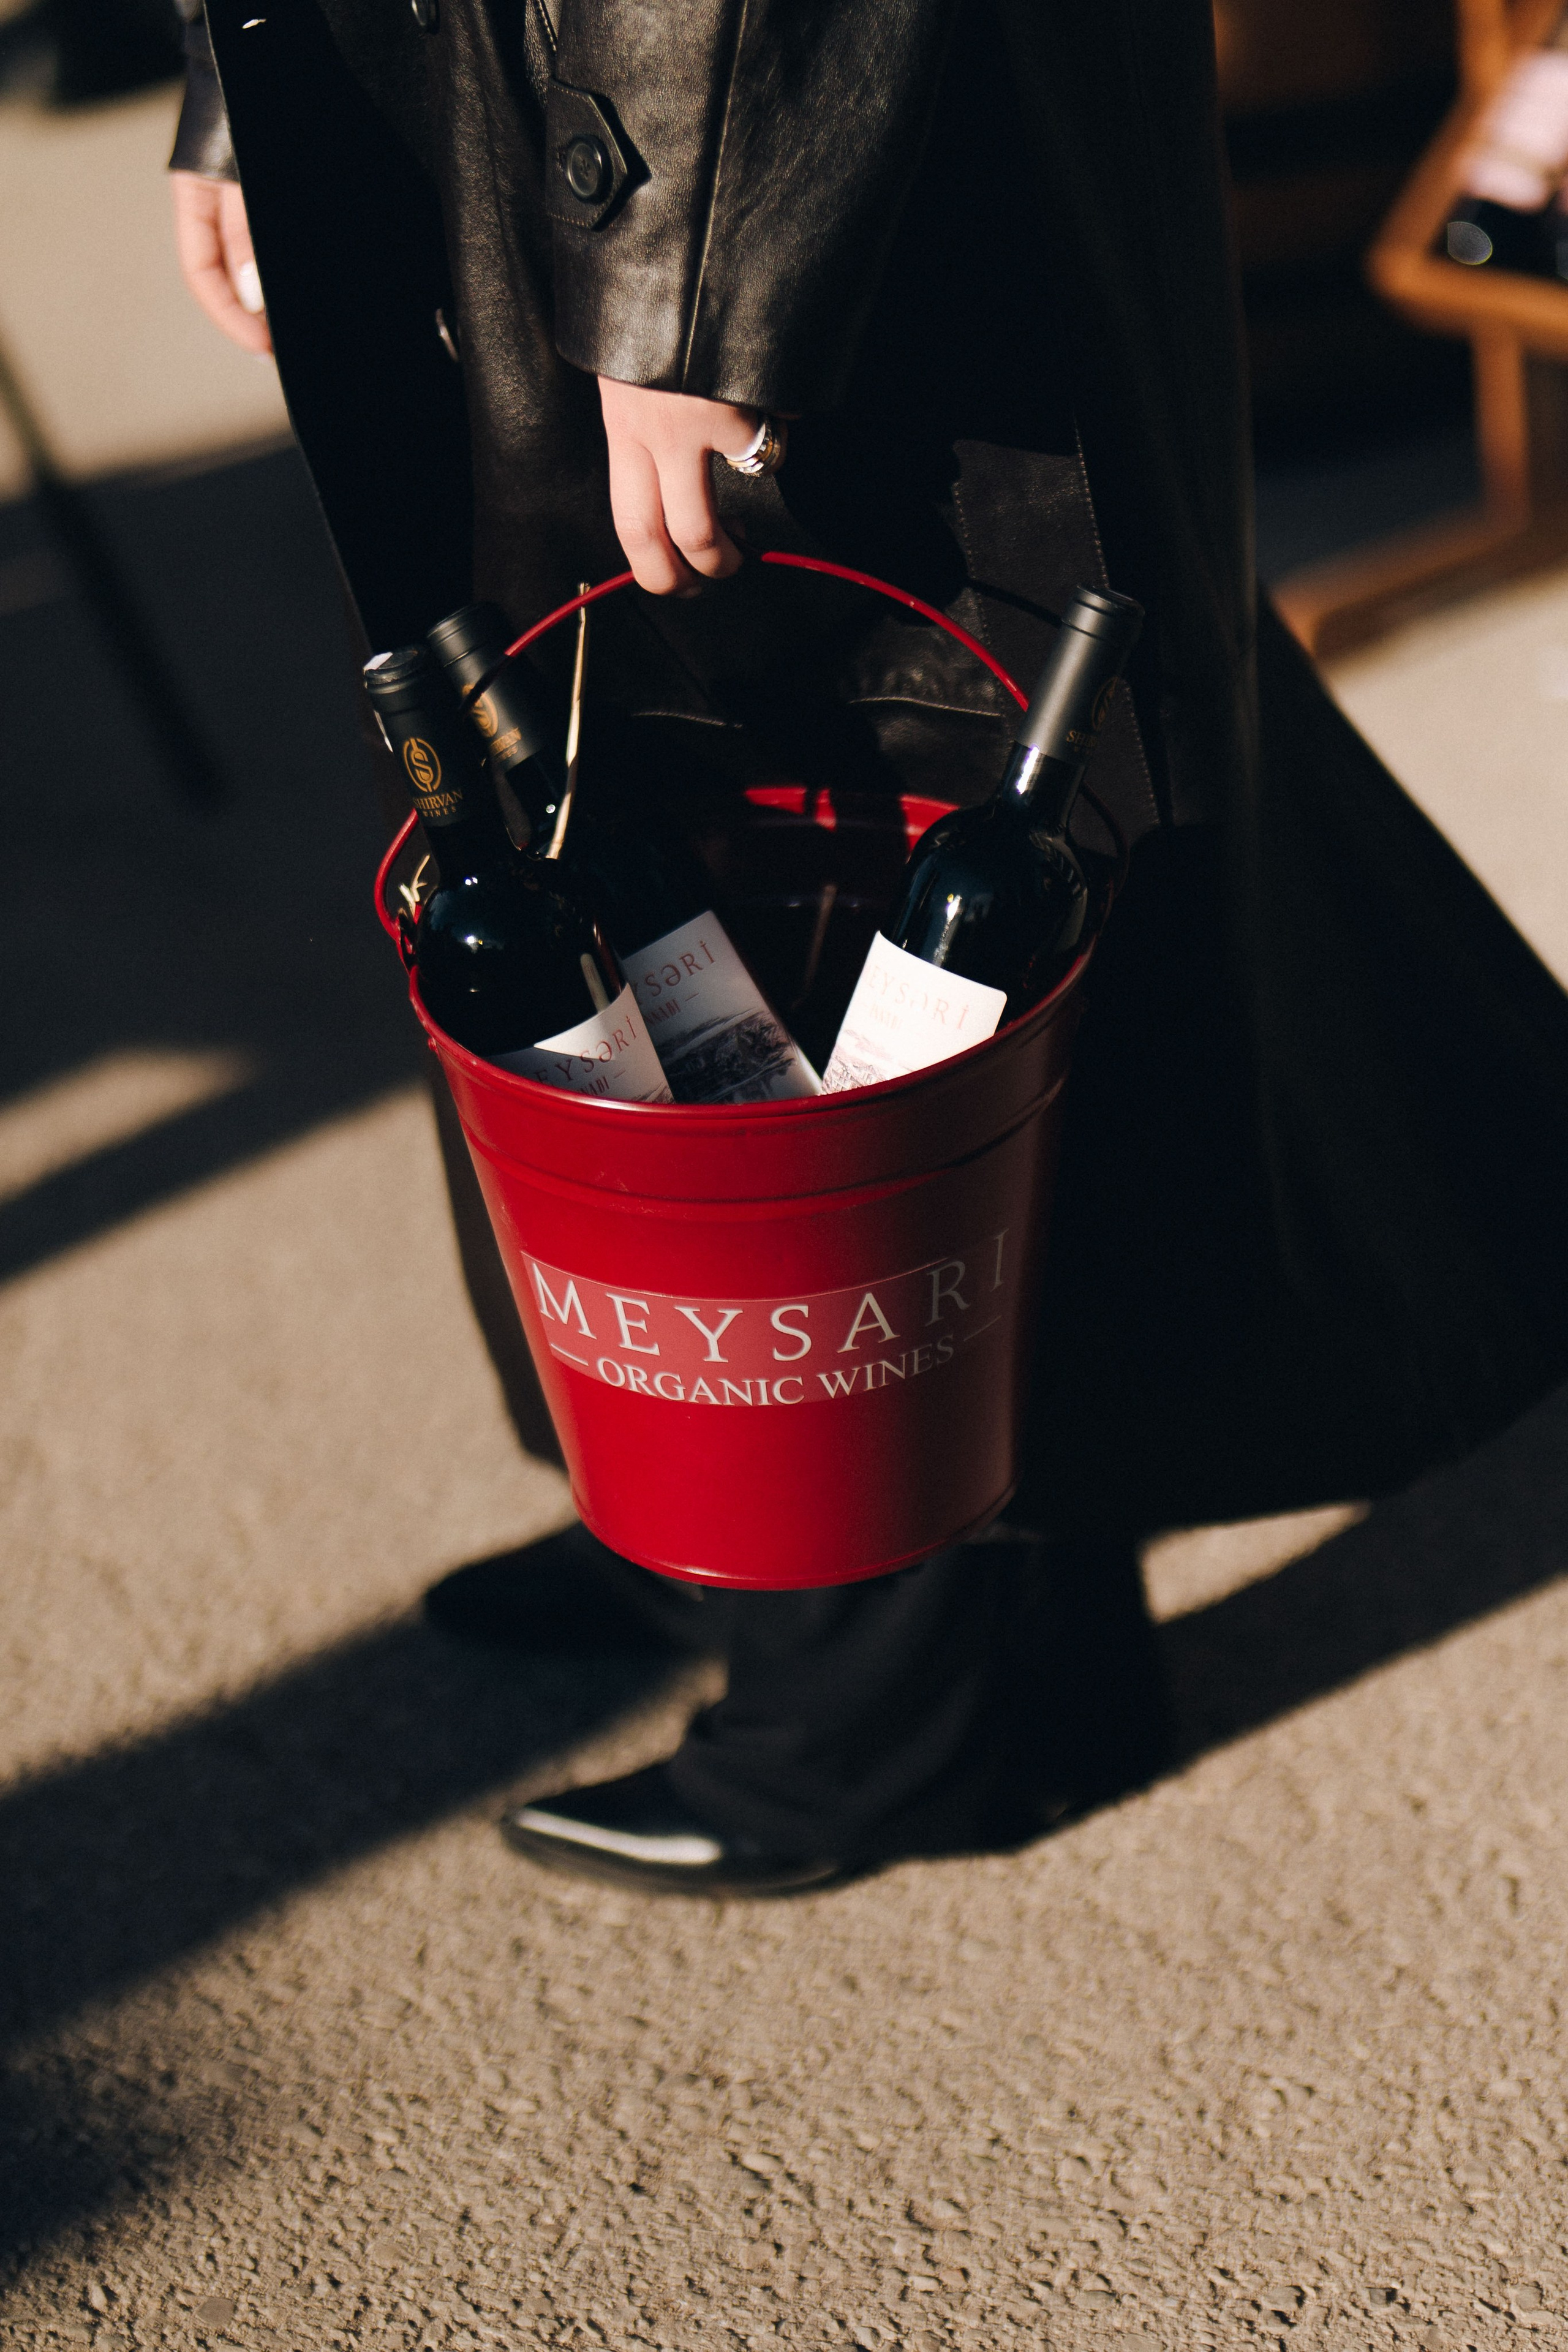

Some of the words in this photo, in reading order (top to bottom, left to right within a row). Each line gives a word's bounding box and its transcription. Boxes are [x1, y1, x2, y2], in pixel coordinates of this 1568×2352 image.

[532, 1228, 1009, 1363] MEYSARI
[598, 1357, 805, 1407] ORGANIC
[817, 1333, 954, 1400] WINES
